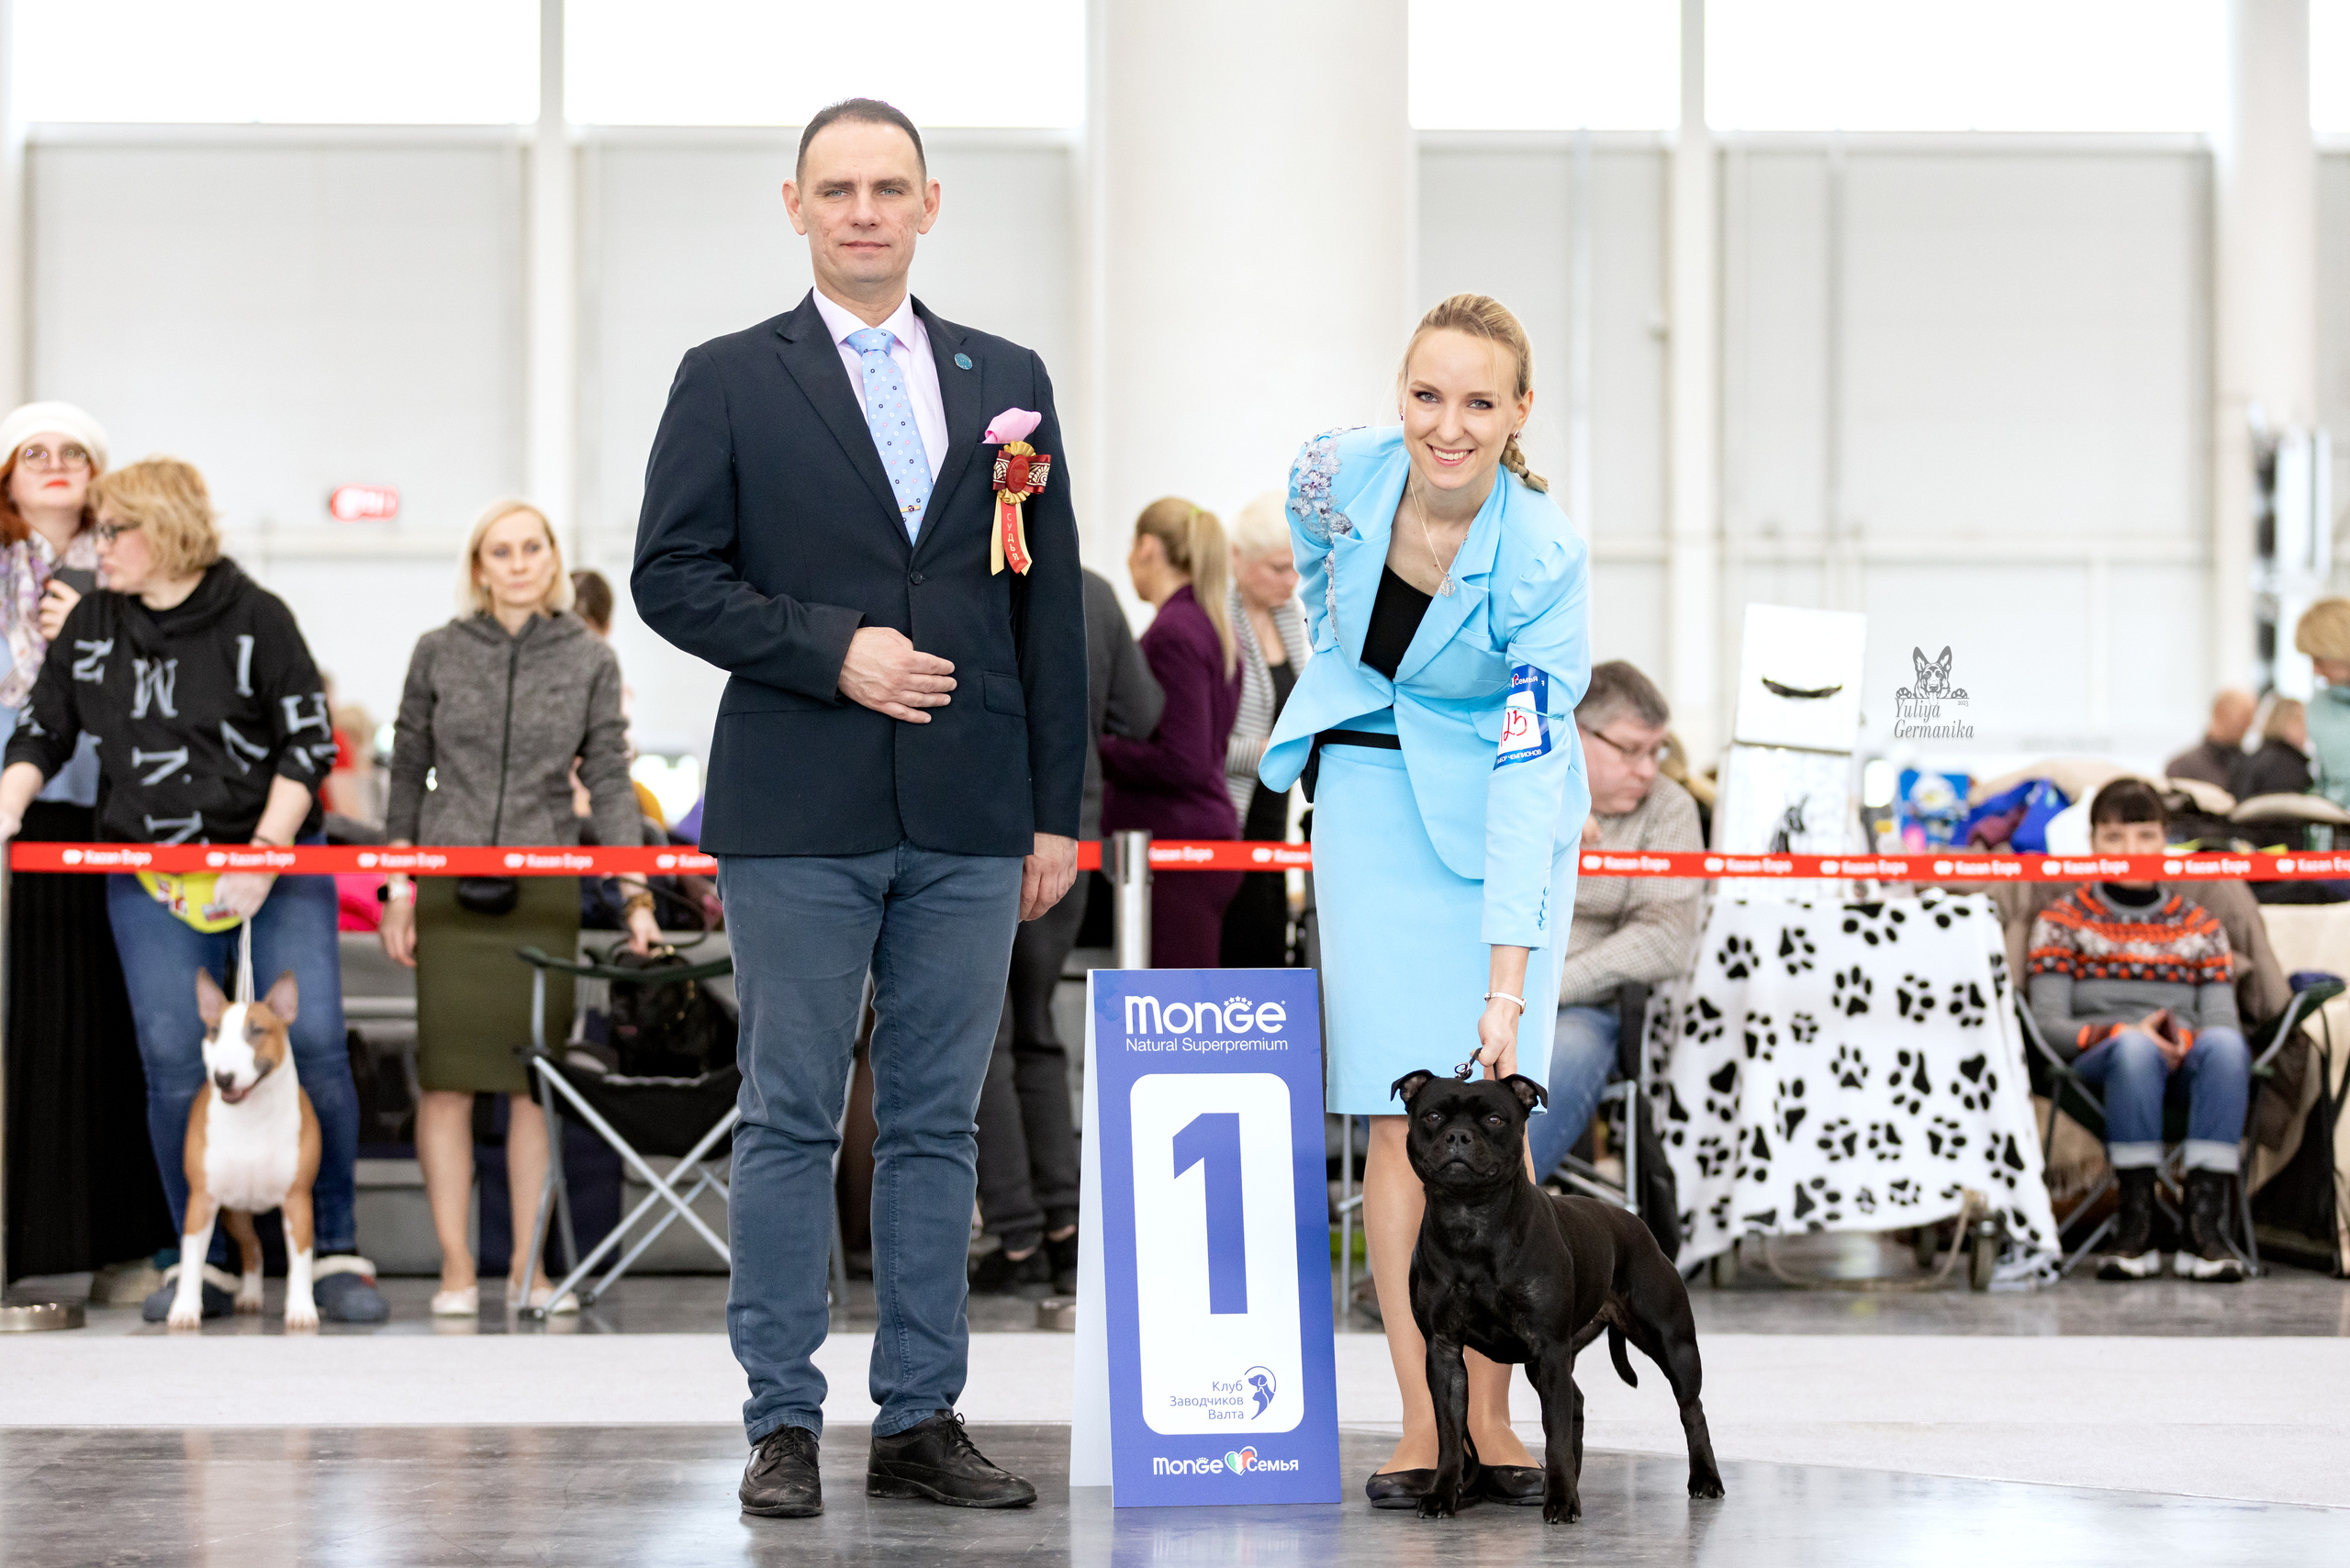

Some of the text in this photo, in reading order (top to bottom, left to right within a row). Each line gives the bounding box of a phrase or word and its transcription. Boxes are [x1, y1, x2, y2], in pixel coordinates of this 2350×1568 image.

[1006, 513, 1020, 561] СУДЬЯ
[1515, 676, 1539, 686] Семья
[1125, 1036, 1289, 1054] Natural Superpremium
[1172, 1113, 1248, 1315] 1
[1212, 1380, 1243, 1394] Клуб
[1169, 1395, 1244, 1407] Заводчиков
[1208, 1409, 1244, 1420] Валта
[1246, 1457, 1299, 1472] Семья
